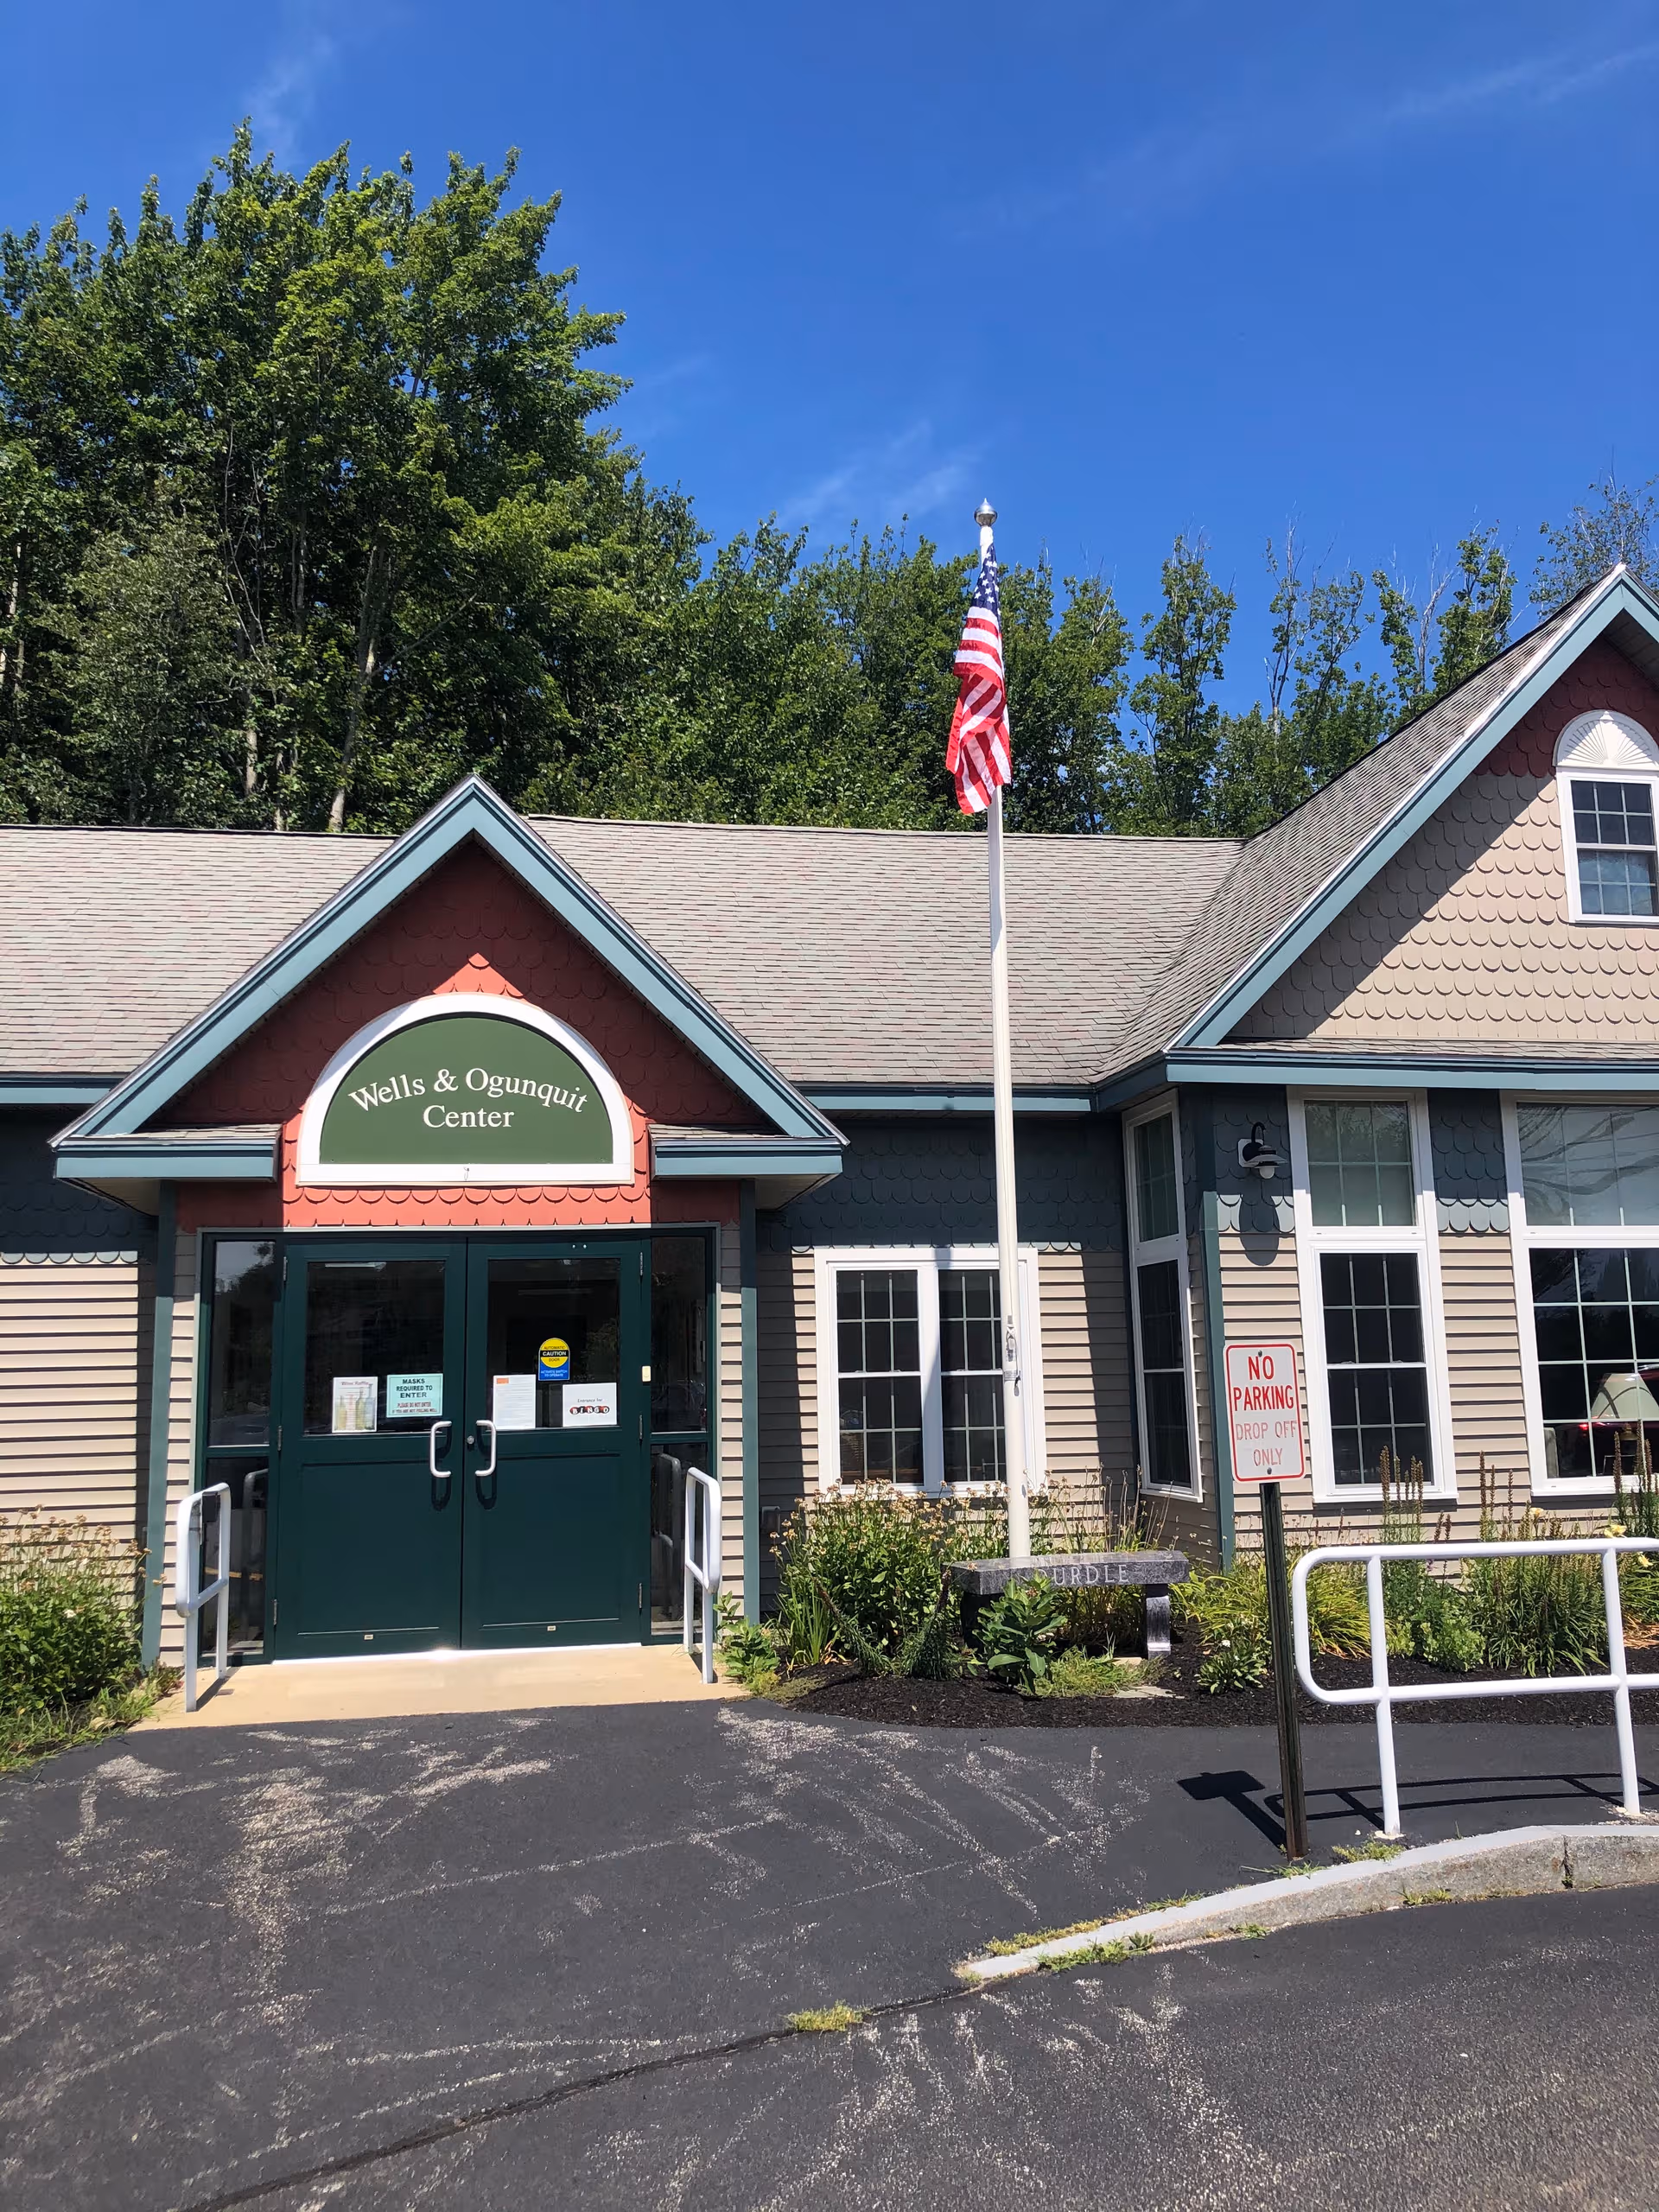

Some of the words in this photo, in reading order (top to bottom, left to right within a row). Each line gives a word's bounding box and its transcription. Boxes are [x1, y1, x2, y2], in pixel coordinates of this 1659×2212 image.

[347, 1074, 426, 1112] Wells
[433, 1068, 459, 1093] &
[465, 1067, 588, 1113] Ogunquit
[423, 1104, 515, 1128] Center
[1248, 1355, 1274, 1380] NO
[570, 1406, 610, 1414] BINGO
[1233, 1385, 1294, 1411] PARKING
[1236, 1422, 1268, 1440] DROP
[1274, 1420, 1298, 1439] OFF
[1253, 1447, 1283, 1466] ONLY
